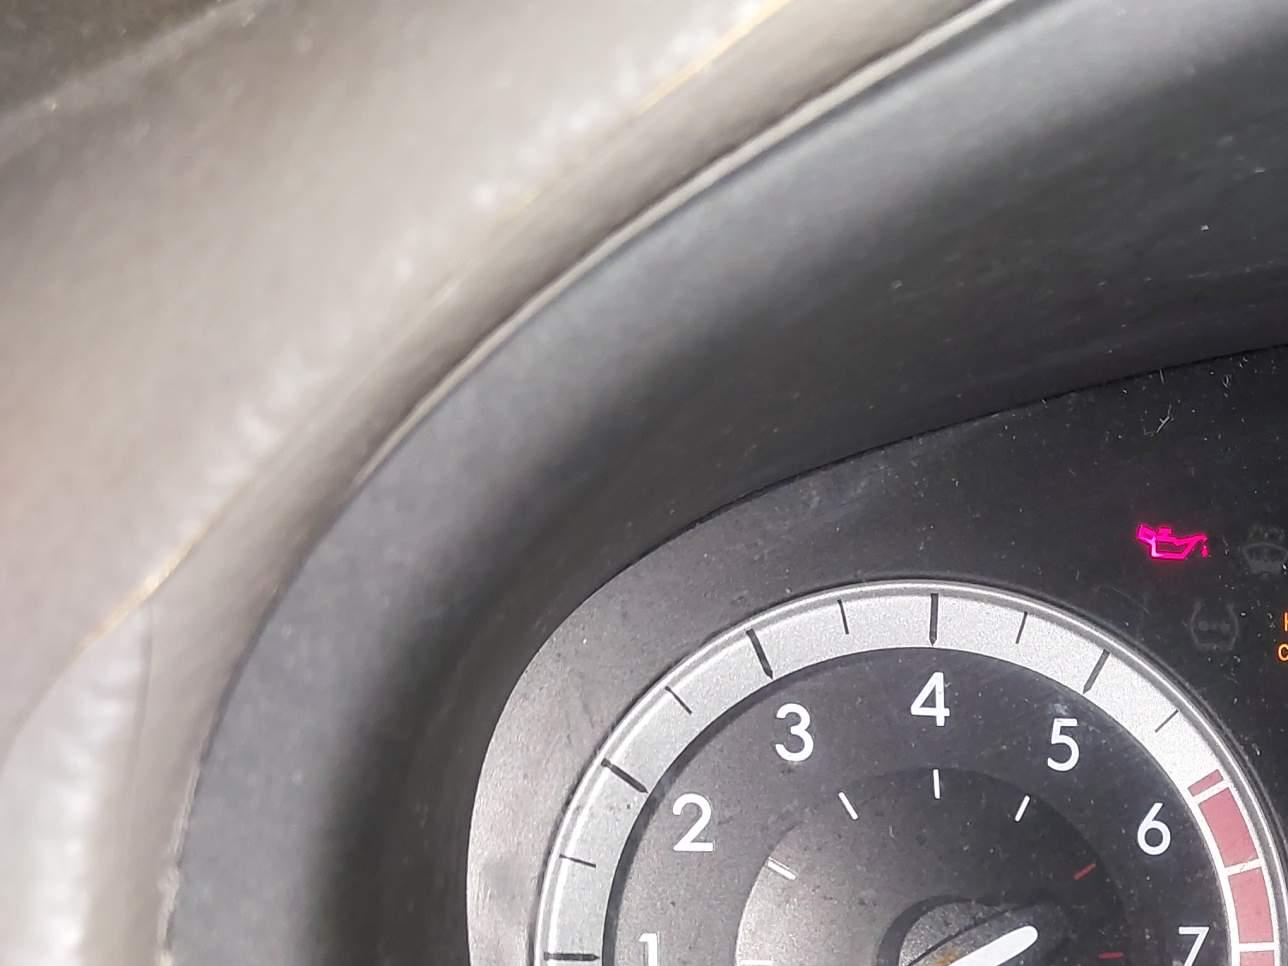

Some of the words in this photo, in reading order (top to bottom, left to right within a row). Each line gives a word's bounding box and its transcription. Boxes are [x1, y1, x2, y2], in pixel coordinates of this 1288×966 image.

[911, 672, 949, 726] 4
[776, 704, 813, 761] 3
[1048, 718, 1079, 771] 5
[673, 794, 713, 851] 2
[1138, 803, 1170, 855] 6
